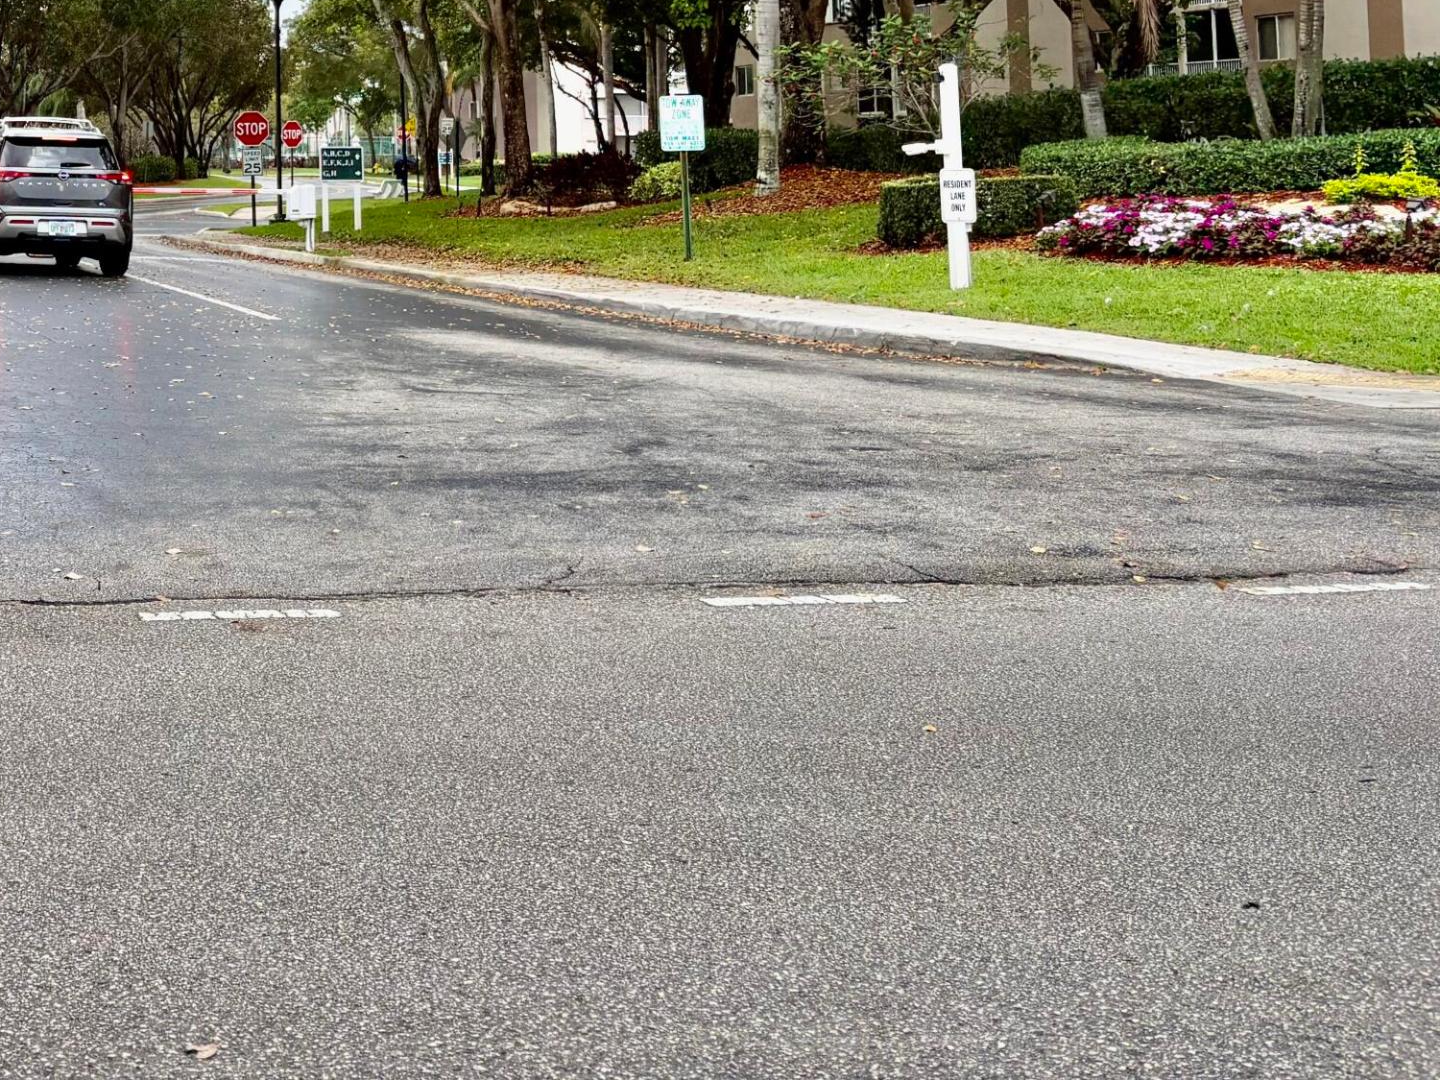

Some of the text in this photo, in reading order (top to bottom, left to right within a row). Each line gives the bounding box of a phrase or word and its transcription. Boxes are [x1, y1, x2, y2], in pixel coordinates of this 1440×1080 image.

[236, 122, 267, 136] STOP
[283, 129, 300, 140] STOP
[244, 163, 261, 174] 25
[943, 179, 972, 189] RESIDENT
[950, 191, 965, 200] LANE
[950, 203, 966, 212] ONLY
